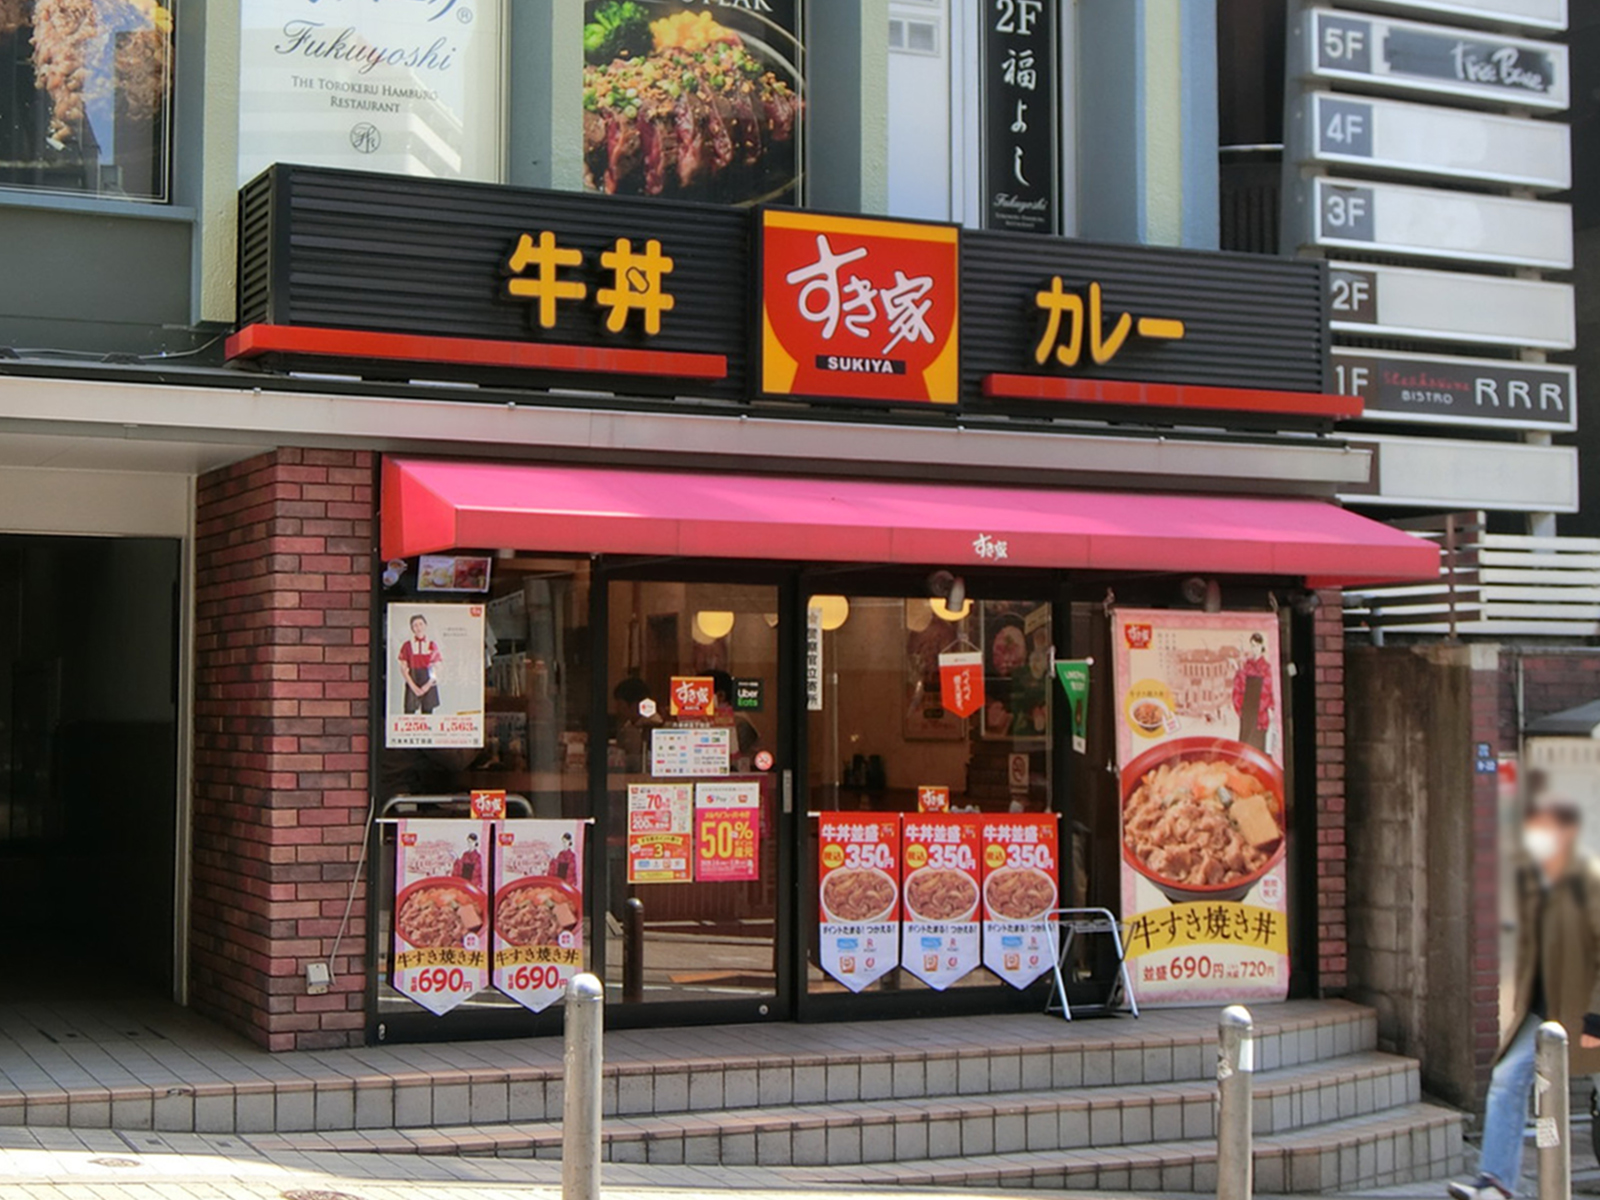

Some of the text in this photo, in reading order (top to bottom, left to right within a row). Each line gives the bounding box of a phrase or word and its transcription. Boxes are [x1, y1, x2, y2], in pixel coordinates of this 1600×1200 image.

[996, 0, 1042, 35] 2F
[274, 20, 456, 75] Fukuyoshi
[1324, 28, 1363, 59] 5F
[291, 75, 314, 89] THE
[318, 78, 379, 96] TOROKERU
[330, 96, 400, 113] RESTAURANT
[1001, 49, 1037, 187] 福よし
[1326, 113, 1363, 144] 4F
[1327, 196, 1365, 227] 3F
[508, 231, 674, 335] 牛丼
[786, 233, 936, 355] すき家
[1331, 279, 1369, 311] 2F
[1035, 275, 1185, 367] カレー
[826, 356, 895, 374] SUKIYA
[1335, 365, 1369, 397] 1F
[1401, 389, 1454, 405] BISTRO
[972, 532, 1008, 562] すき家
[675, 681, 710, 707] すき家
[737, 689, 759, 698] Uber
[1132, 905, 1277, 949] 牛すき焼き丼
[397, 950, 484, 968] 牛すき焼き丼
[496, 949, 579, 966] 牛すき焼き丼
[418, 967, 473, 993] 690円
